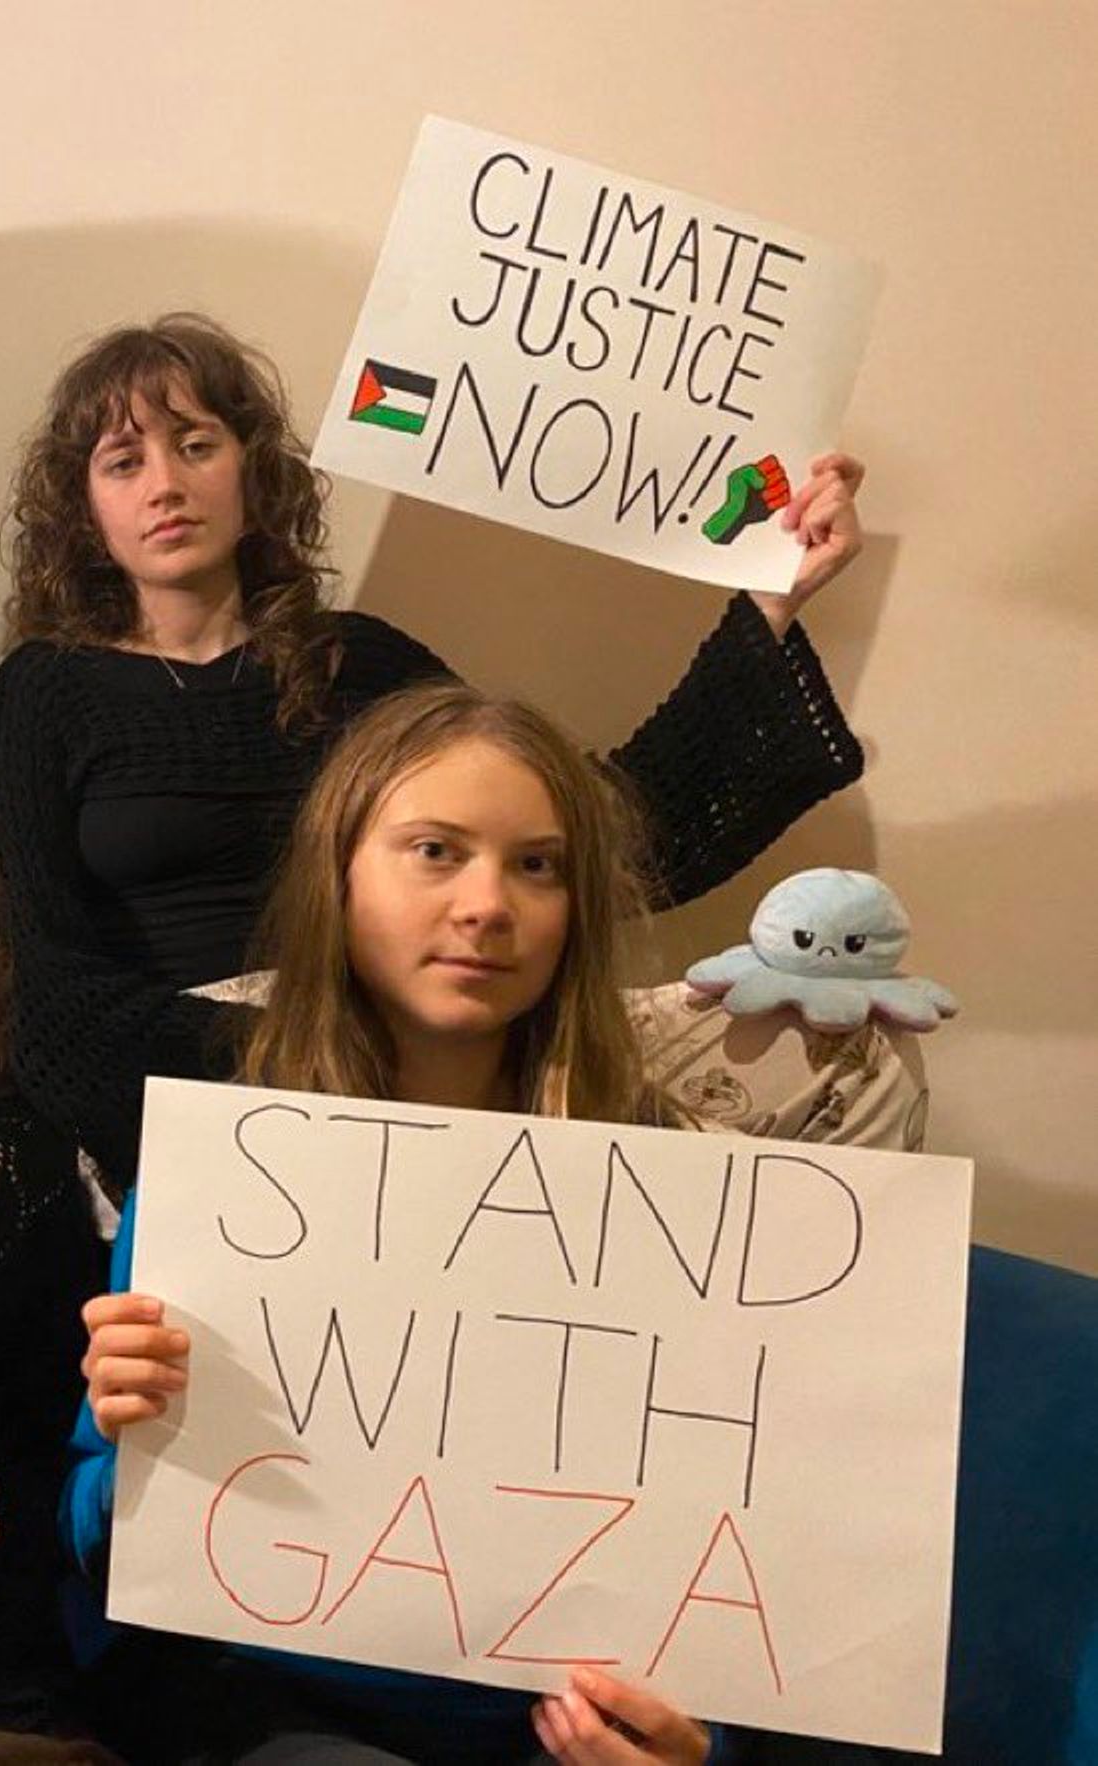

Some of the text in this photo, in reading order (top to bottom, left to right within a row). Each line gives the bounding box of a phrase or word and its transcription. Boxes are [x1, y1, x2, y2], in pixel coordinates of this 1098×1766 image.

[451, 251, 775, 421] JUSTICE
[469, 152, 806, 328] CLIMATE
[218, 1103, 863, 1306] STAND
[260, 1296, 766, 1508] WITH
[205, 1453, 782, 1695] GAZA
